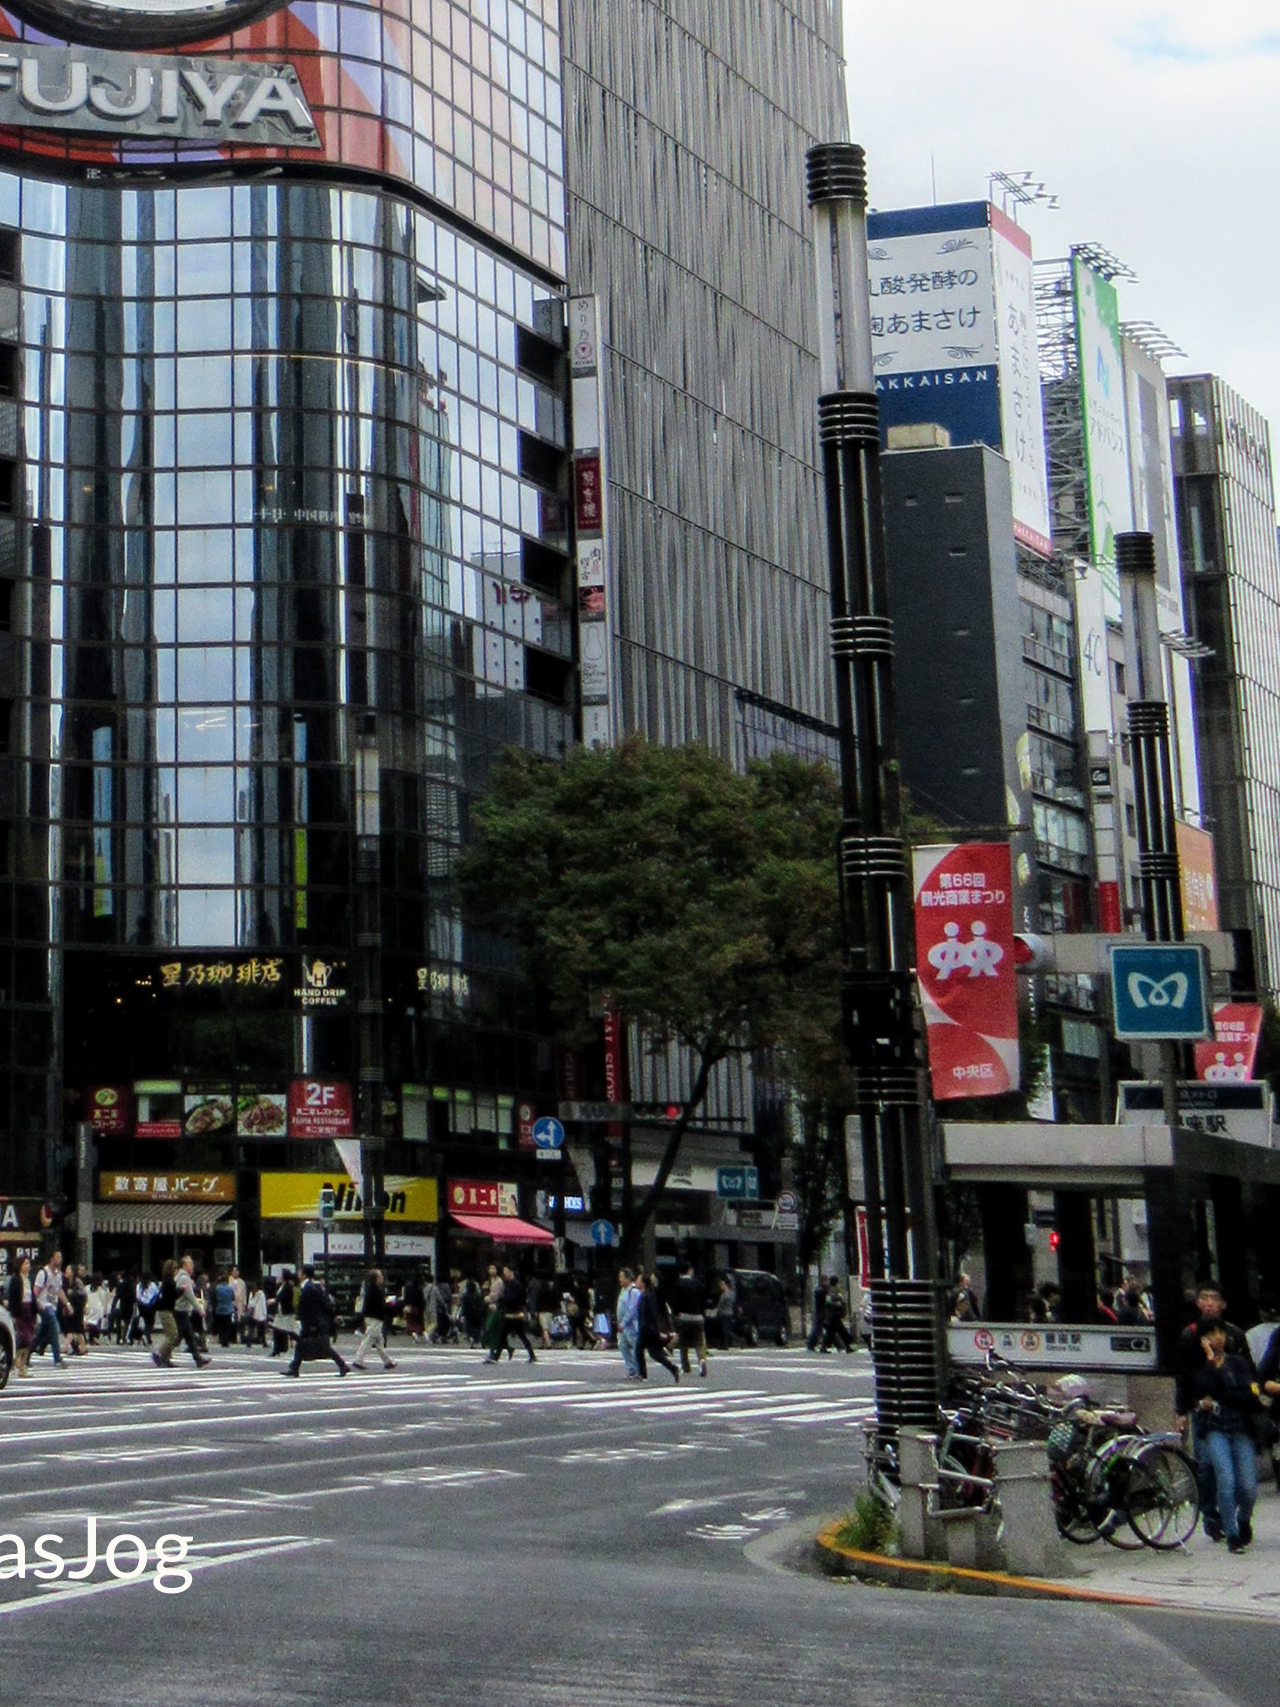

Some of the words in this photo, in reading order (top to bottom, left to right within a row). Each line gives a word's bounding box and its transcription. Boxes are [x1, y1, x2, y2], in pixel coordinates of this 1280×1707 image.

[874, 370, 988, 391] AKKAISAN
[939, 872, 986, 889] 第66回
[160, 956, 285, 988] 星乃珈琲店
[293, 988, 320, 997] HAND
[322, 988, 347, 997] DRIP
[301, 997, 338, 1006] COFFEE
[952, 1062, 995, 1079] 中央区
[306, 1082, 336, 1106] 2F
[1180, 1115, 1227, 1133] 座駅
[114, 1175, 220, 1193] 数寄屋バーグ
[320, 1180, 407, 1214] Nion
[469, 1187, 498, 1207] 不二家
